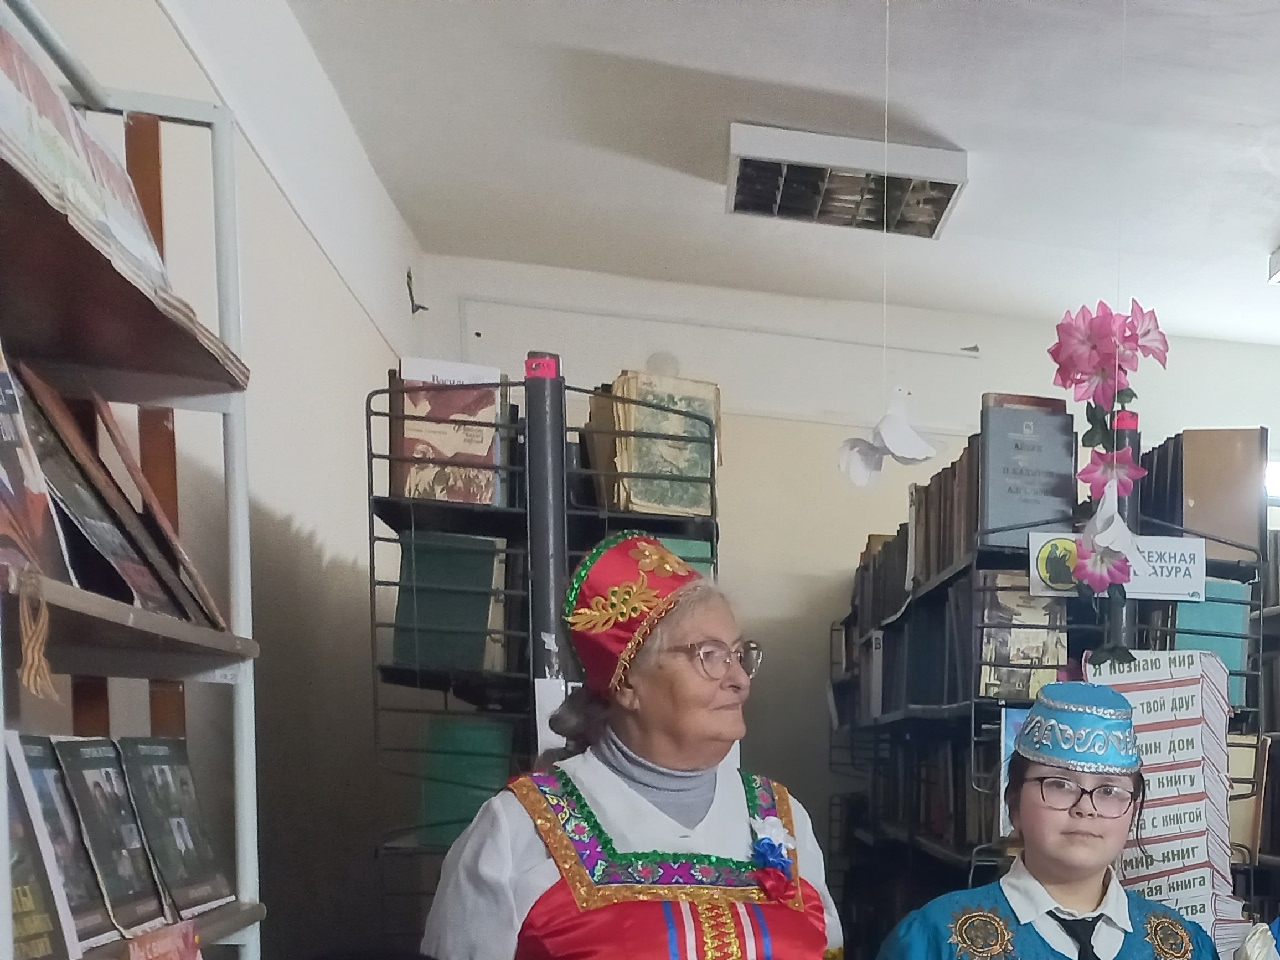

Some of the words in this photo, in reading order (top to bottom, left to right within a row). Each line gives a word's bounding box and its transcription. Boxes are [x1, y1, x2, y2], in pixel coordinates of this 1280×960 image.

[1168, 653, 1195, 670] мир
[1139, 696, 1166, 715] твой
[1170, 694, 1196, 713] друг
[1167, 737, 1195, 756] дом
[1157, 774, 1196, 789] книгу
[1151, 816, 1158, 829] с
[1162, 807, 1202, 828] книгой
[1123, 853, 1155, 872] мир
[1162, 846, 1199, 865] книг
[1167, 875, 1206, 893] книга
